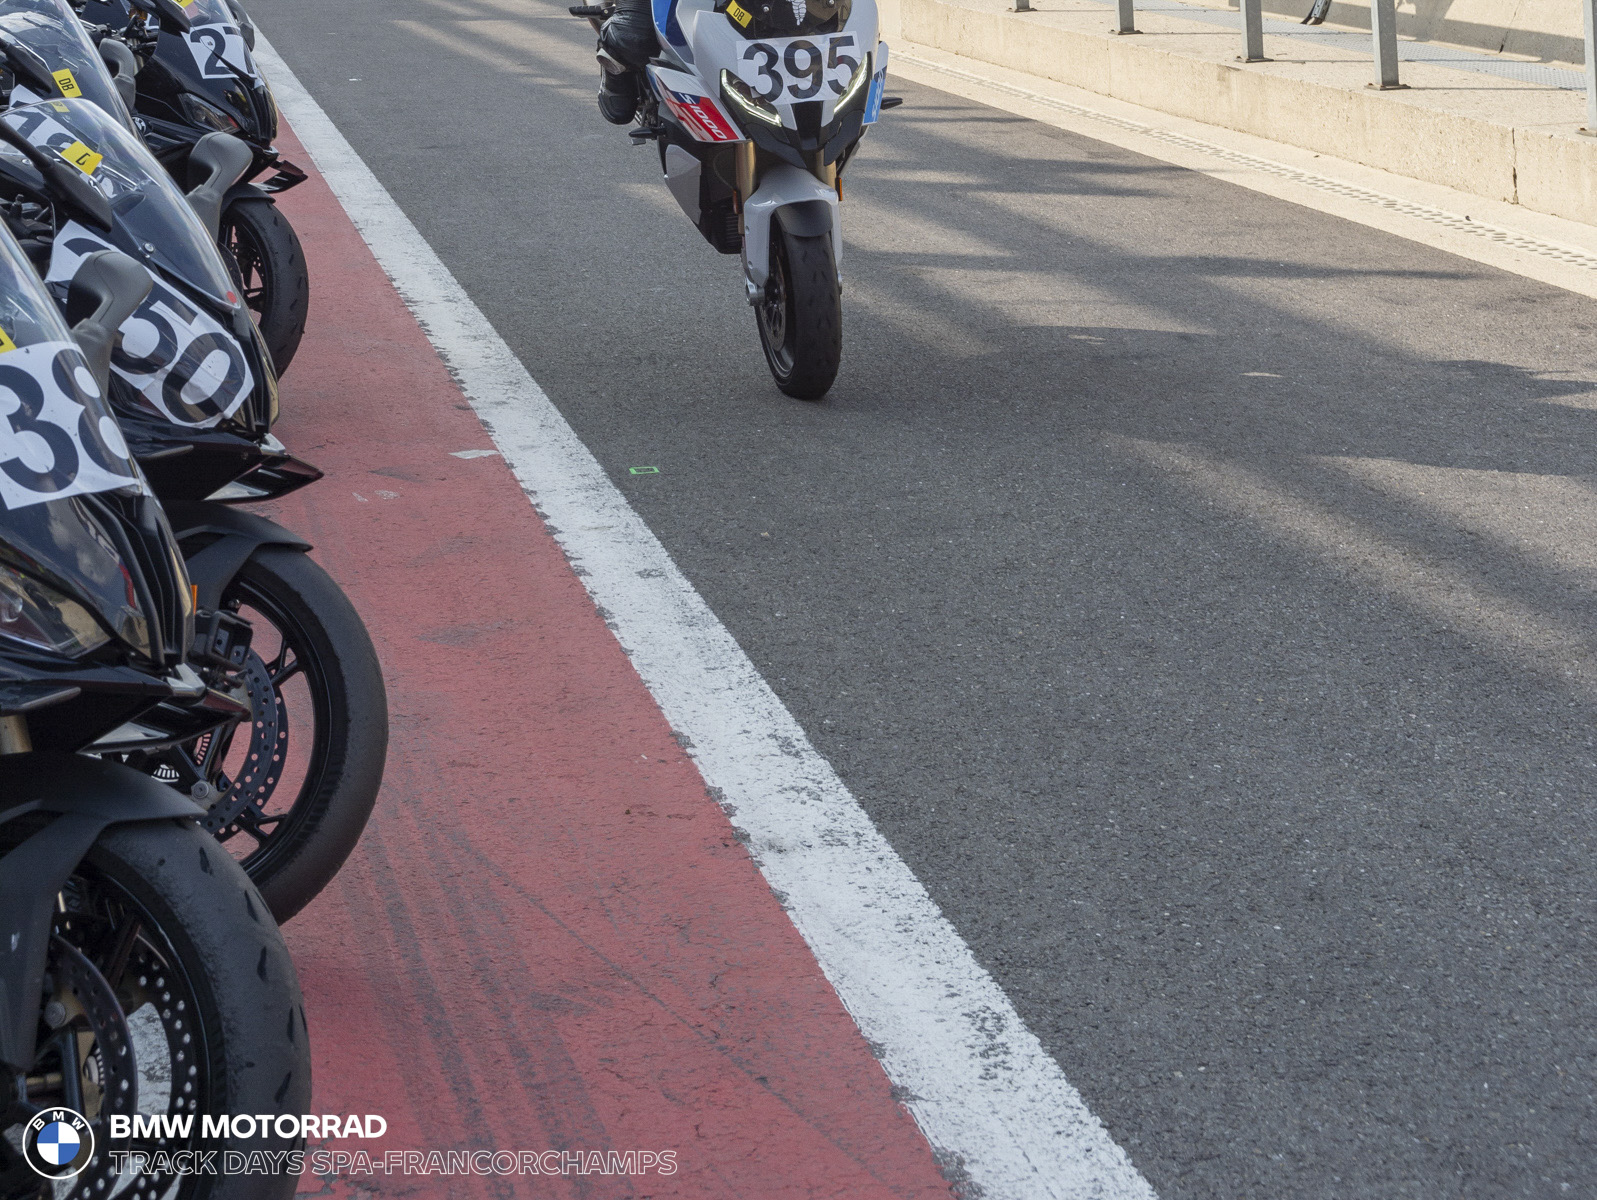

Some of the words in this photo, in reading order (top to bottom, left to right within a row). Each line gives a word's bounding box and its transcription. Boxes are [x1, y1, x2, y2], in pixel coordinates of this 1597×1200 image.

[733, 7, 745, 21] DB
[58, 78, 75, 91] DB
[743, 36, 859, 102] 395
[679, 92, 728, 140] S1000
